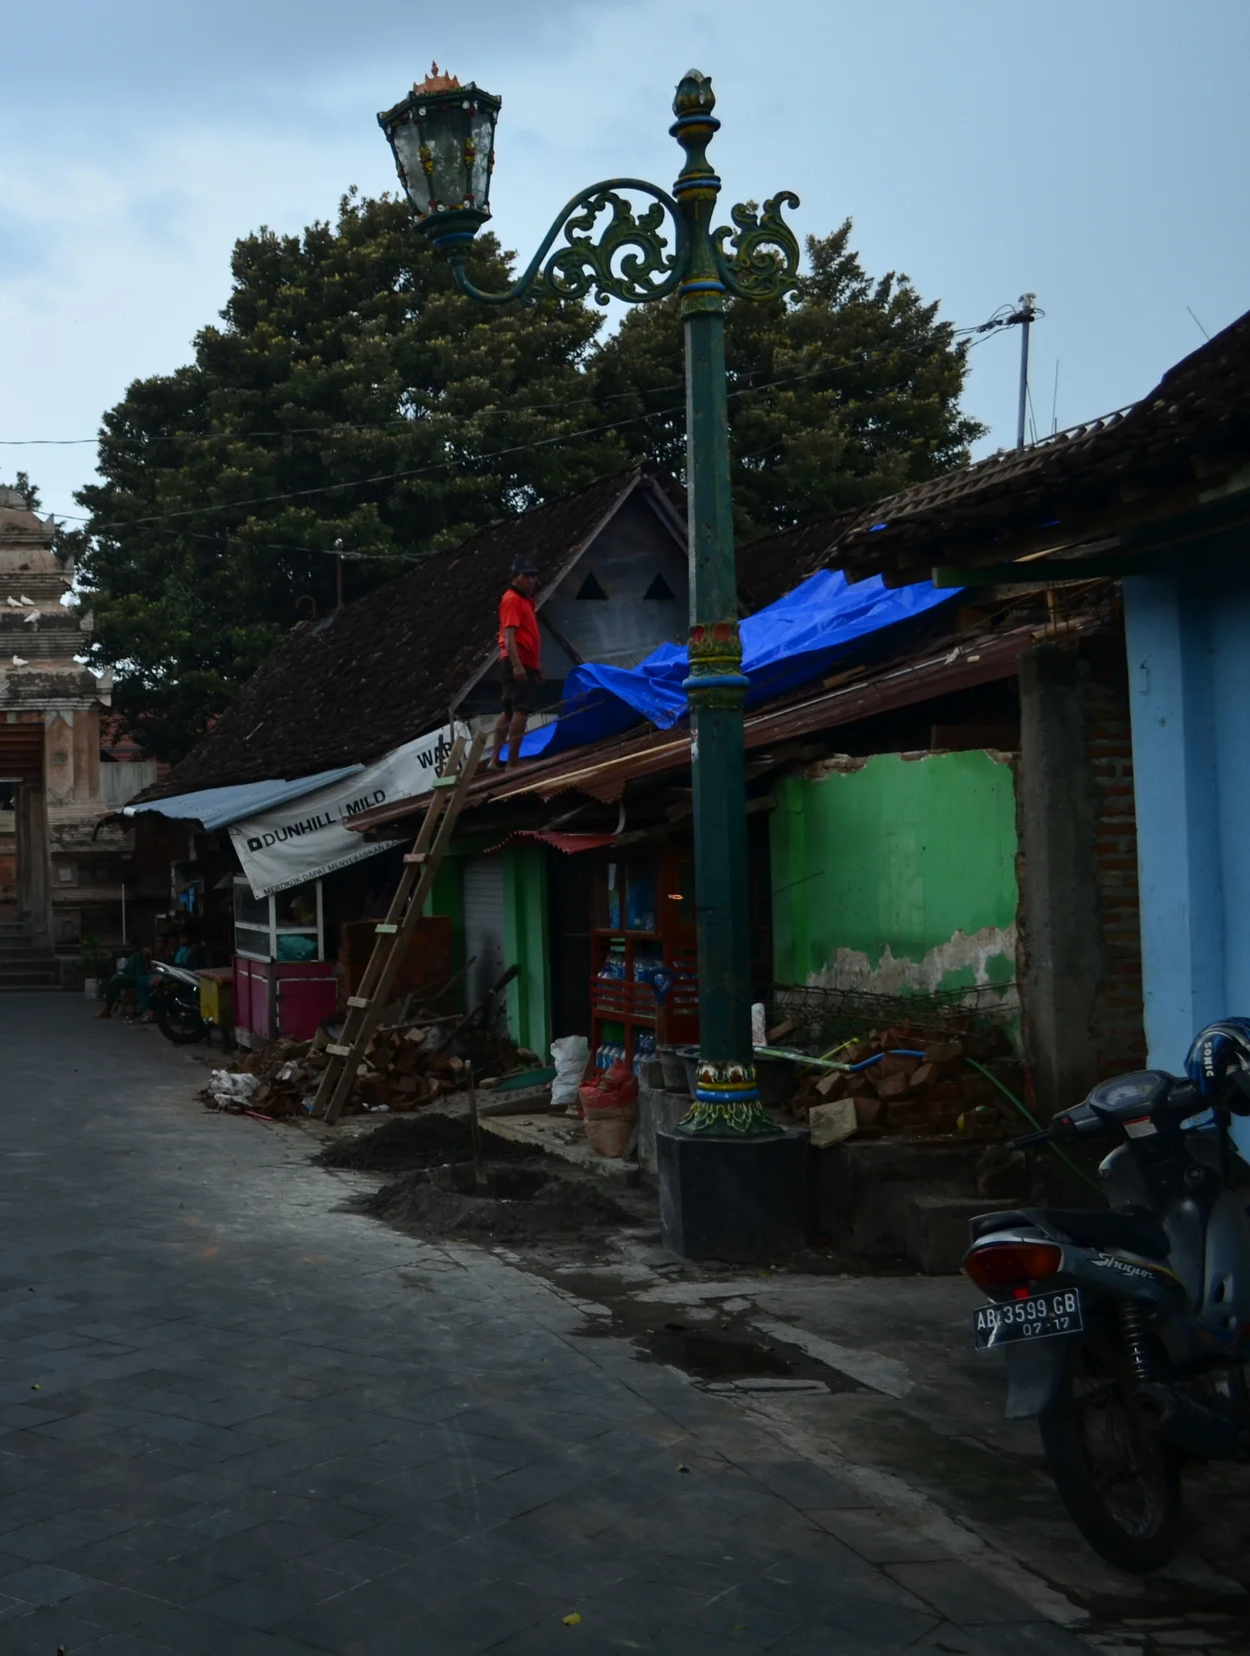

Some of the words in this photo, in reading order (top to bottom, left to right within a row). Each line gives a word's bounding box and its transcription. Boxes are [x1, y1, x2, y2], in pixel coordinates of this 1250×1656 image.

[262, 811, 337, 847] DUNHILL
[345, 789, 387, 817] MILD
[263, 875, 301, 896] MEROKOK
[302, 866, 327, 881] DAPAT
[1203, 1041, 1215, 1078] SONIC
[1089, 1252, 1157, 1280] Shogun
[977, 1308, 998, 1331] AB
[1003, 1298, 1047, 1325] 3599
[1052, 1293, 1076, 1315] GB
